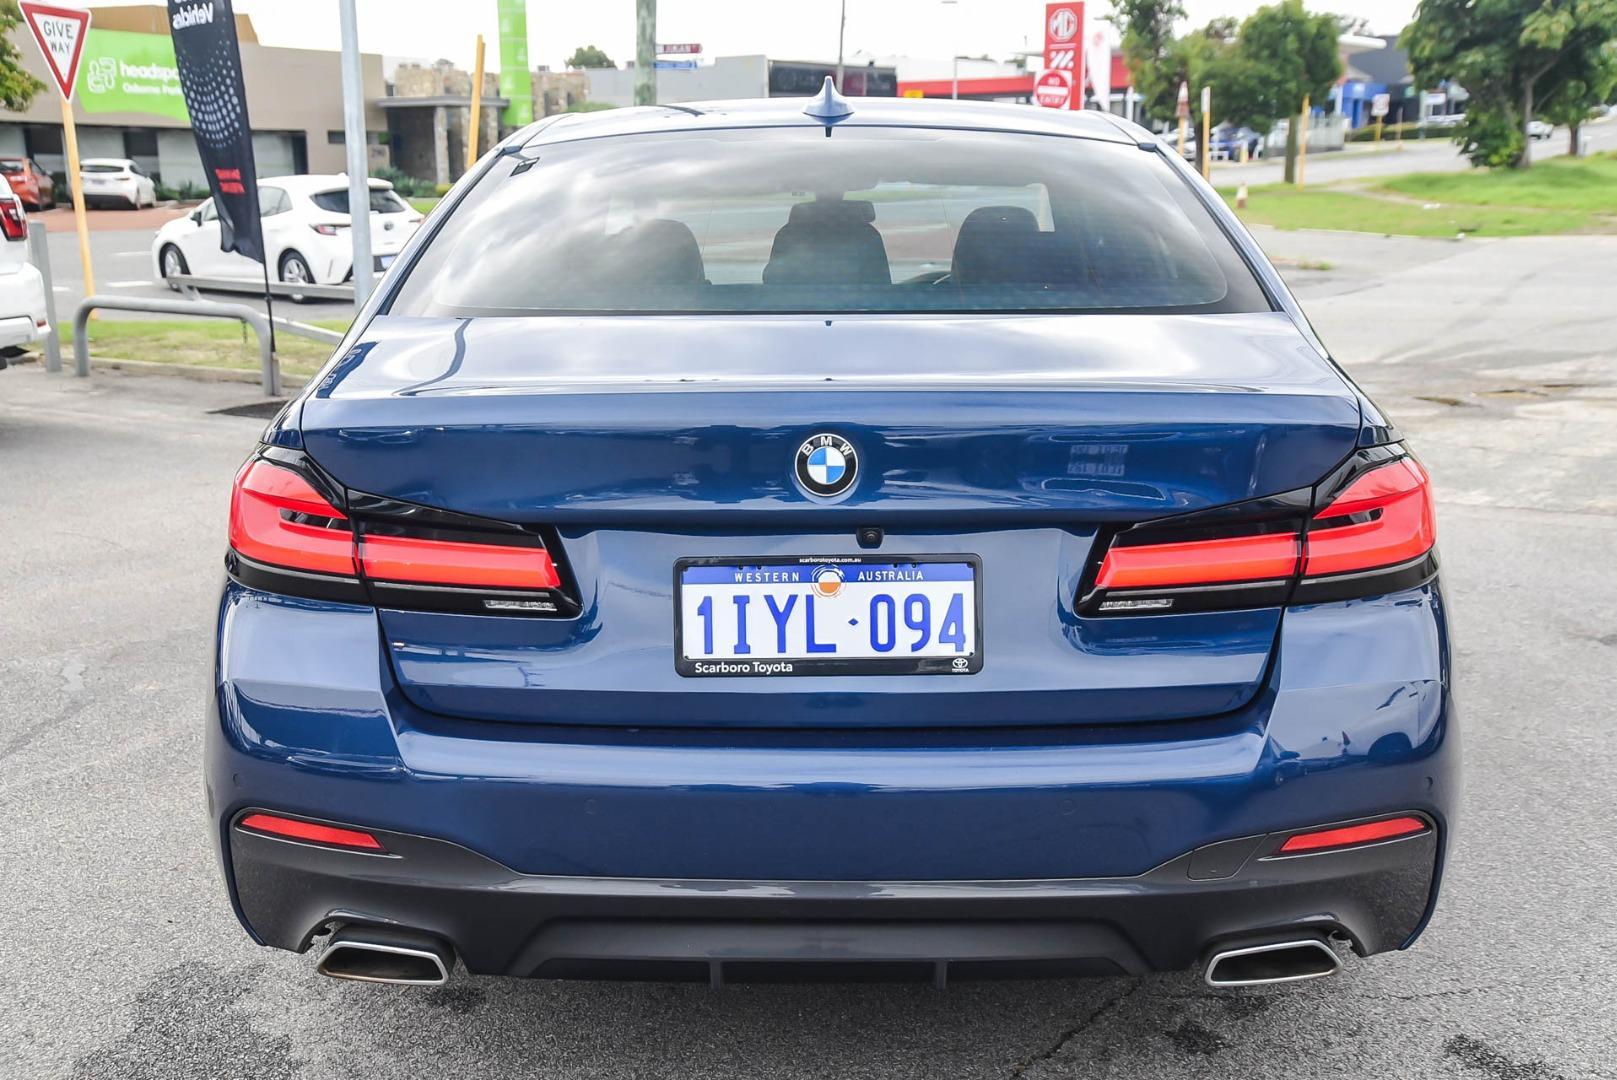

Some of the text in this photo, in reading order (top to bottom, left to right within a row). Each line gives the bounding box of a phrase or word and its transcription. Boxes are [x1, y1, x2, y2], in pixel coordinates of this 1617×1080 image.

[43, 20, 74, 39] GIVE
[1051, 11, 1076, 39] MG
[50, 40, 71, 55] WAY
[1047, 76, 1060, 86] NO
[801, 435, 853, 457] BMW
[734, 571, 924, 583] WESTERN AUSTRALIA
[697, 594, 837, 655] 1IYL
[694, 661, 793, 675] Scarboro Toyota
